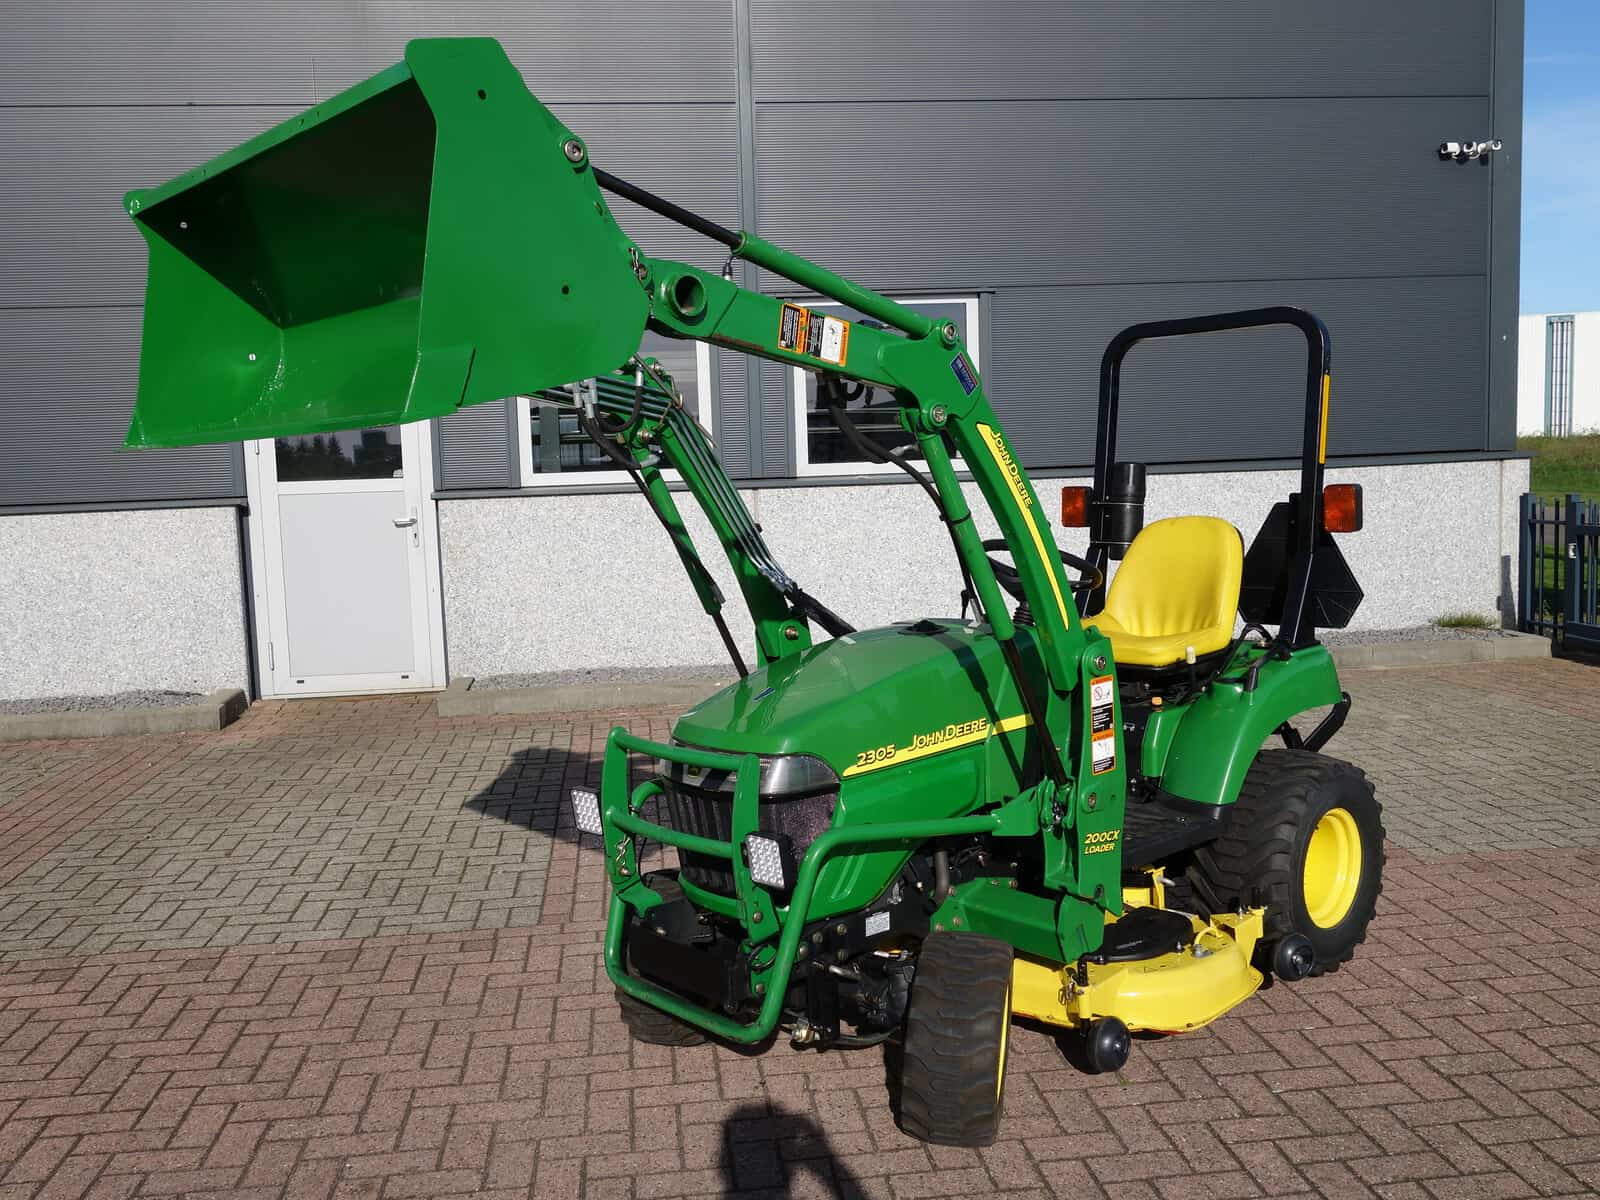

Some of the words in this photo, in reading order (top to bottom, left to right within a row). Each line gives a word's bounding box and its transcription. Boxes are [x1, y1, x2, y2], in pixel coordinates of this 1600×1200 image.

[856, 744, 897, 767] 2305
[1084, 830, 1120, 845] 200CX
[1084, 842, 1115, 855] LOADER
